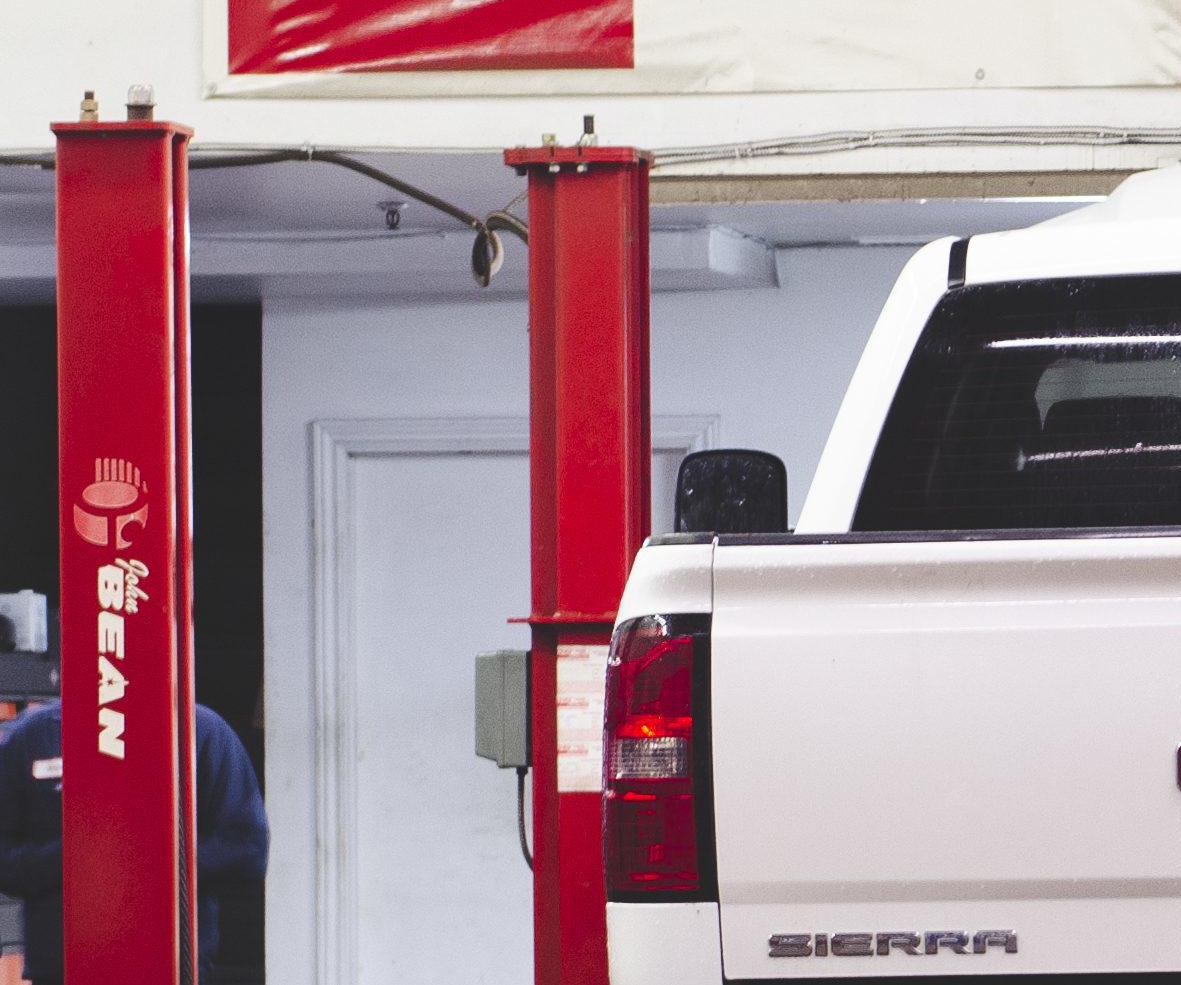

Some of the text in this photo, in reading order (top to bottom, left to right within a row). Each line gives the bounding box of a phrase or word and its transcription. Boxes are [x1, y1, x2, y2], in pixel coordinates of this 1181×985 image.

[115, 558, 149, 614] John
[97, 564, 129, 760] BEAN
[767, 928, 1019, 958] SIERRA
